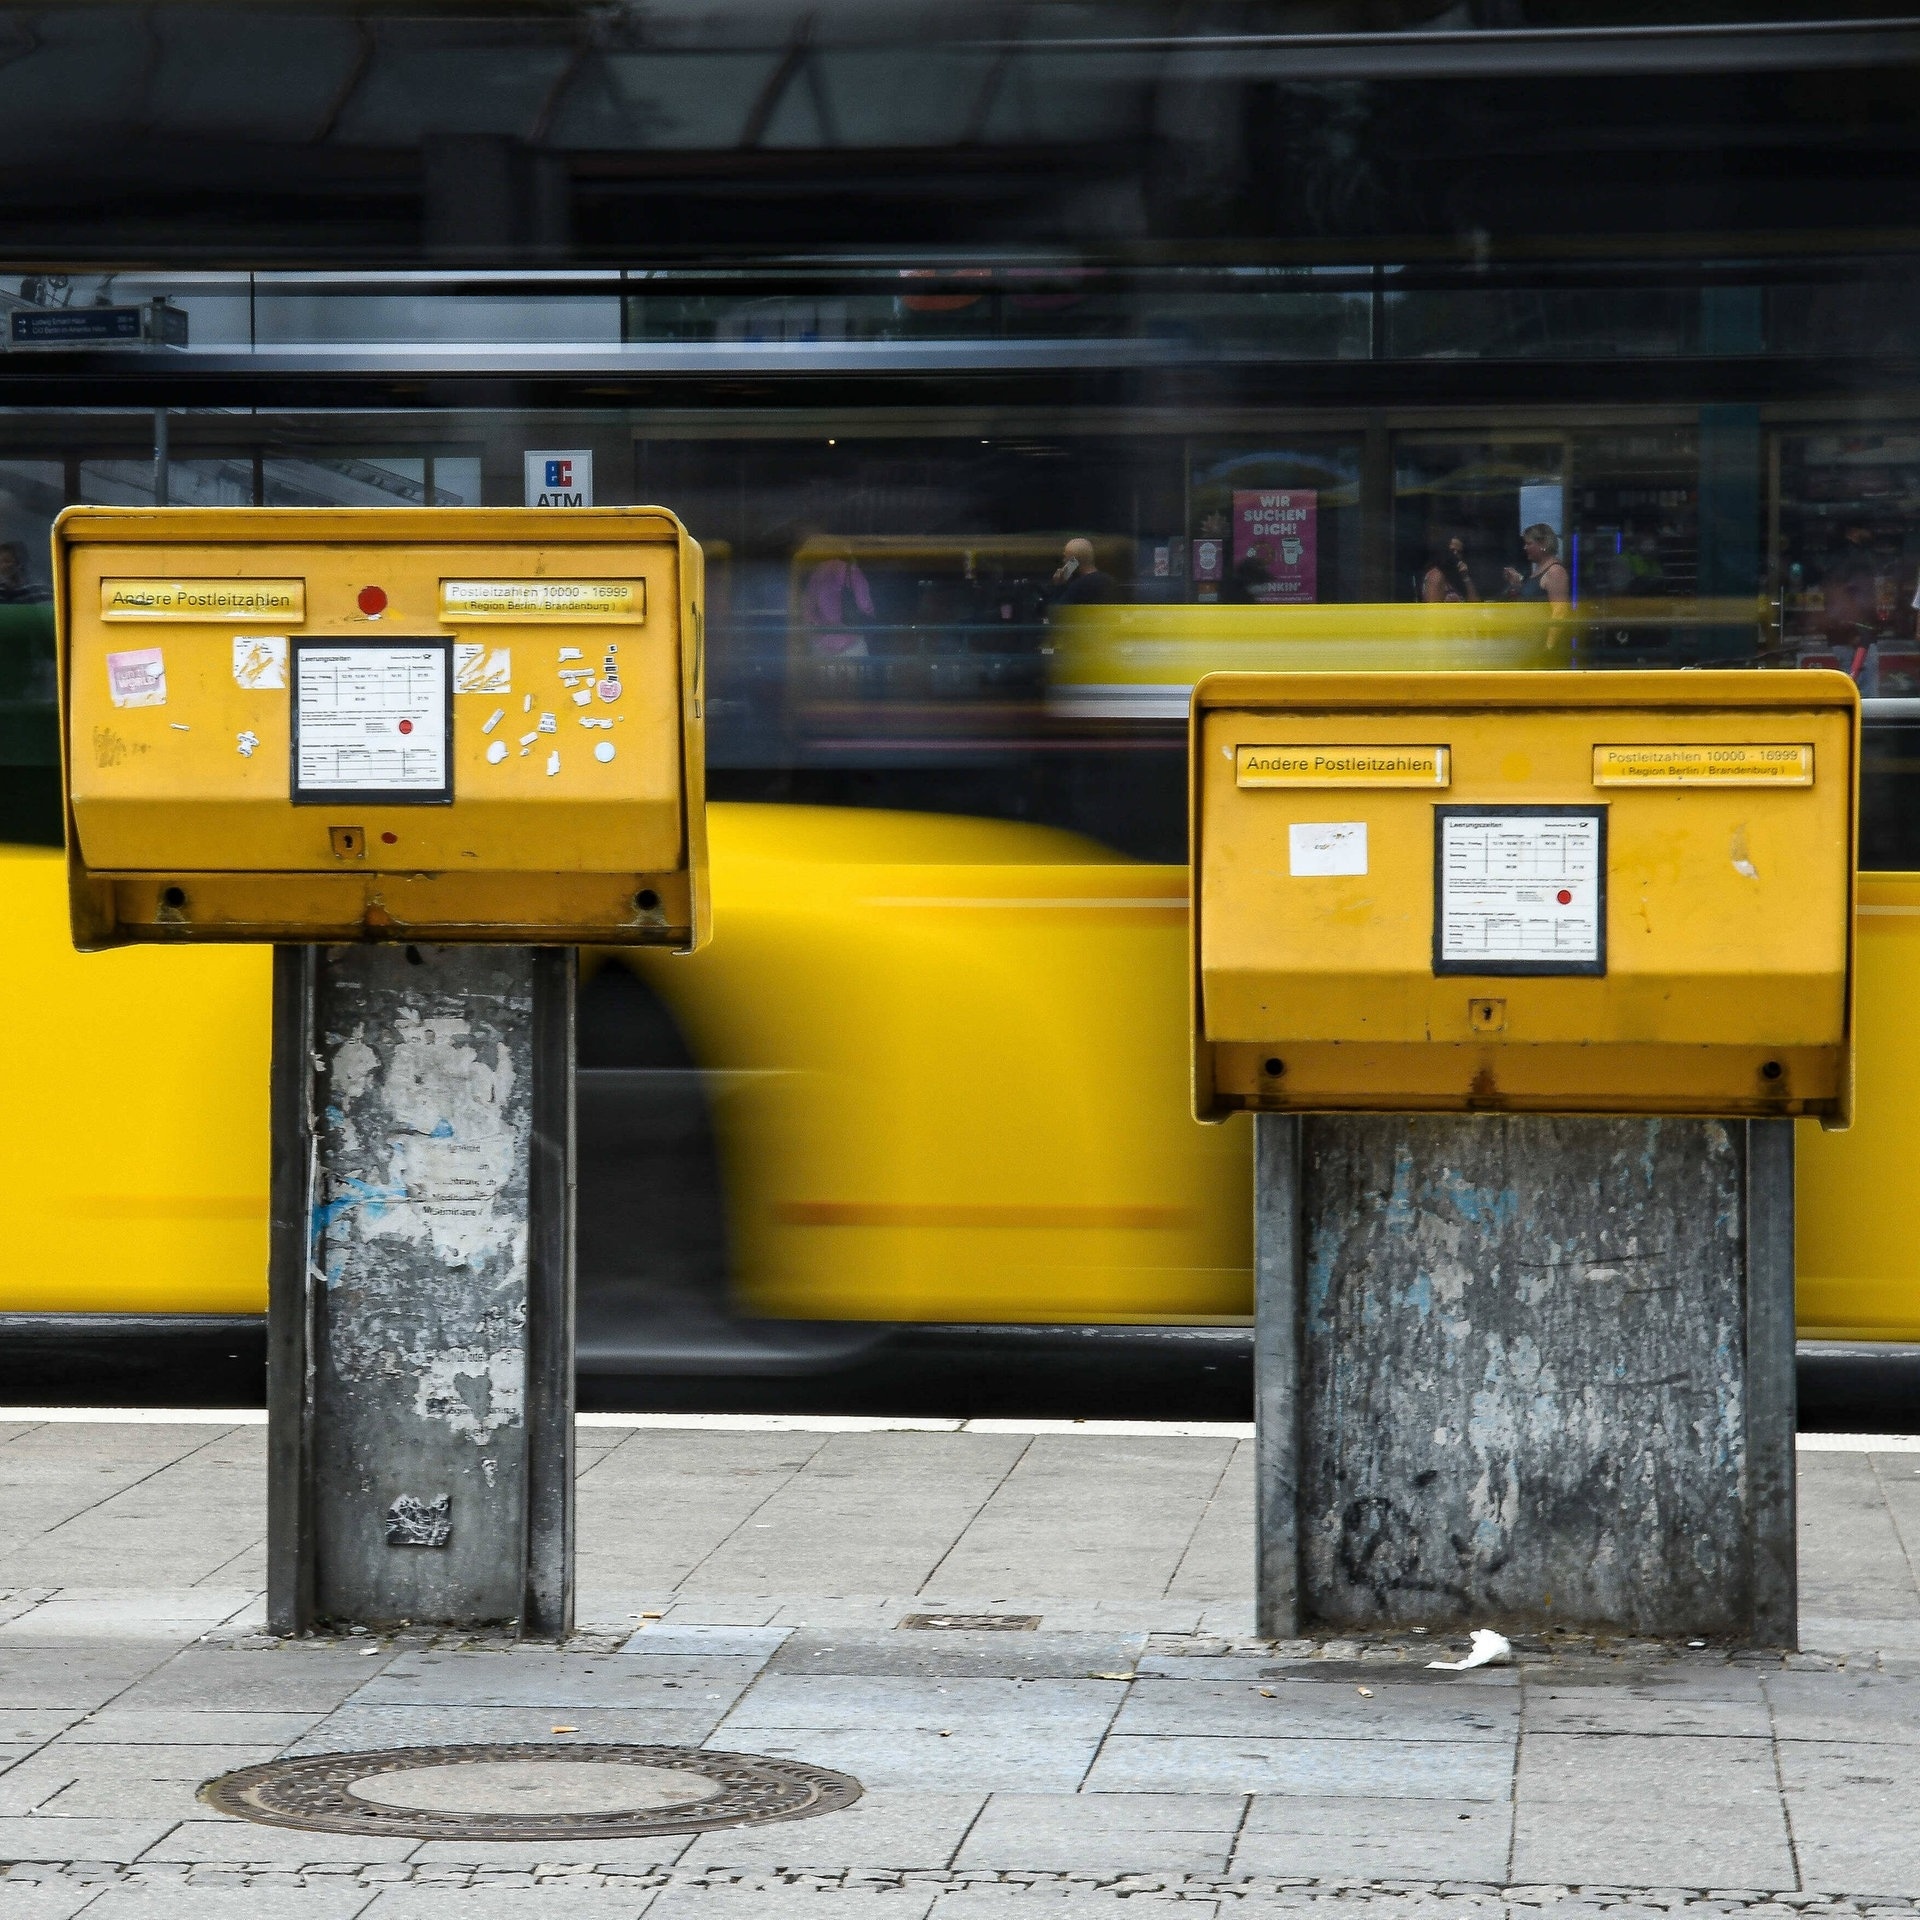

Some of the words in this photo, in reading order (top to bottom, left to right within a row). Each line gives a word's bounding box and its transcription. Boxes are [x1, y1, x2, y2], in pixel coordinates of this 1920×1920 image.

[537, 493, 583, 507] ATM
[1260, 495, 1291, 508] WIR
[1244, 509, 1307, 521] SUCHEN
[1253, 523, 1297, 535] DICH!
[452, 586, 539, 598] Postleitzahlen
[544, 586, 580, 598] 10000
[592, 586, 629, 598] 16999
[112, 590, 172, 606] Andere
[177, 591, 291, 607] Postleitzahlen
[470, 602, 506, 612] Region
[508, 602, 537, 611] Berlin
[545, 602, 610, 612] Brandenburg
[1608, 751, 1701, 763] Postleitzahlen
[1707, 750, 1746, 762] 10000
[1760, 750, 1799, 761] 16999
[1247, 756, 1309, 771] Andere
[1314, 756, 1433, 771] Postleitzahlen
[1628, 766, 1666, 777] Region
[1668, 765, 1700, 776] Berlin
[1708, 765, 1779, 776] Brandenburg
